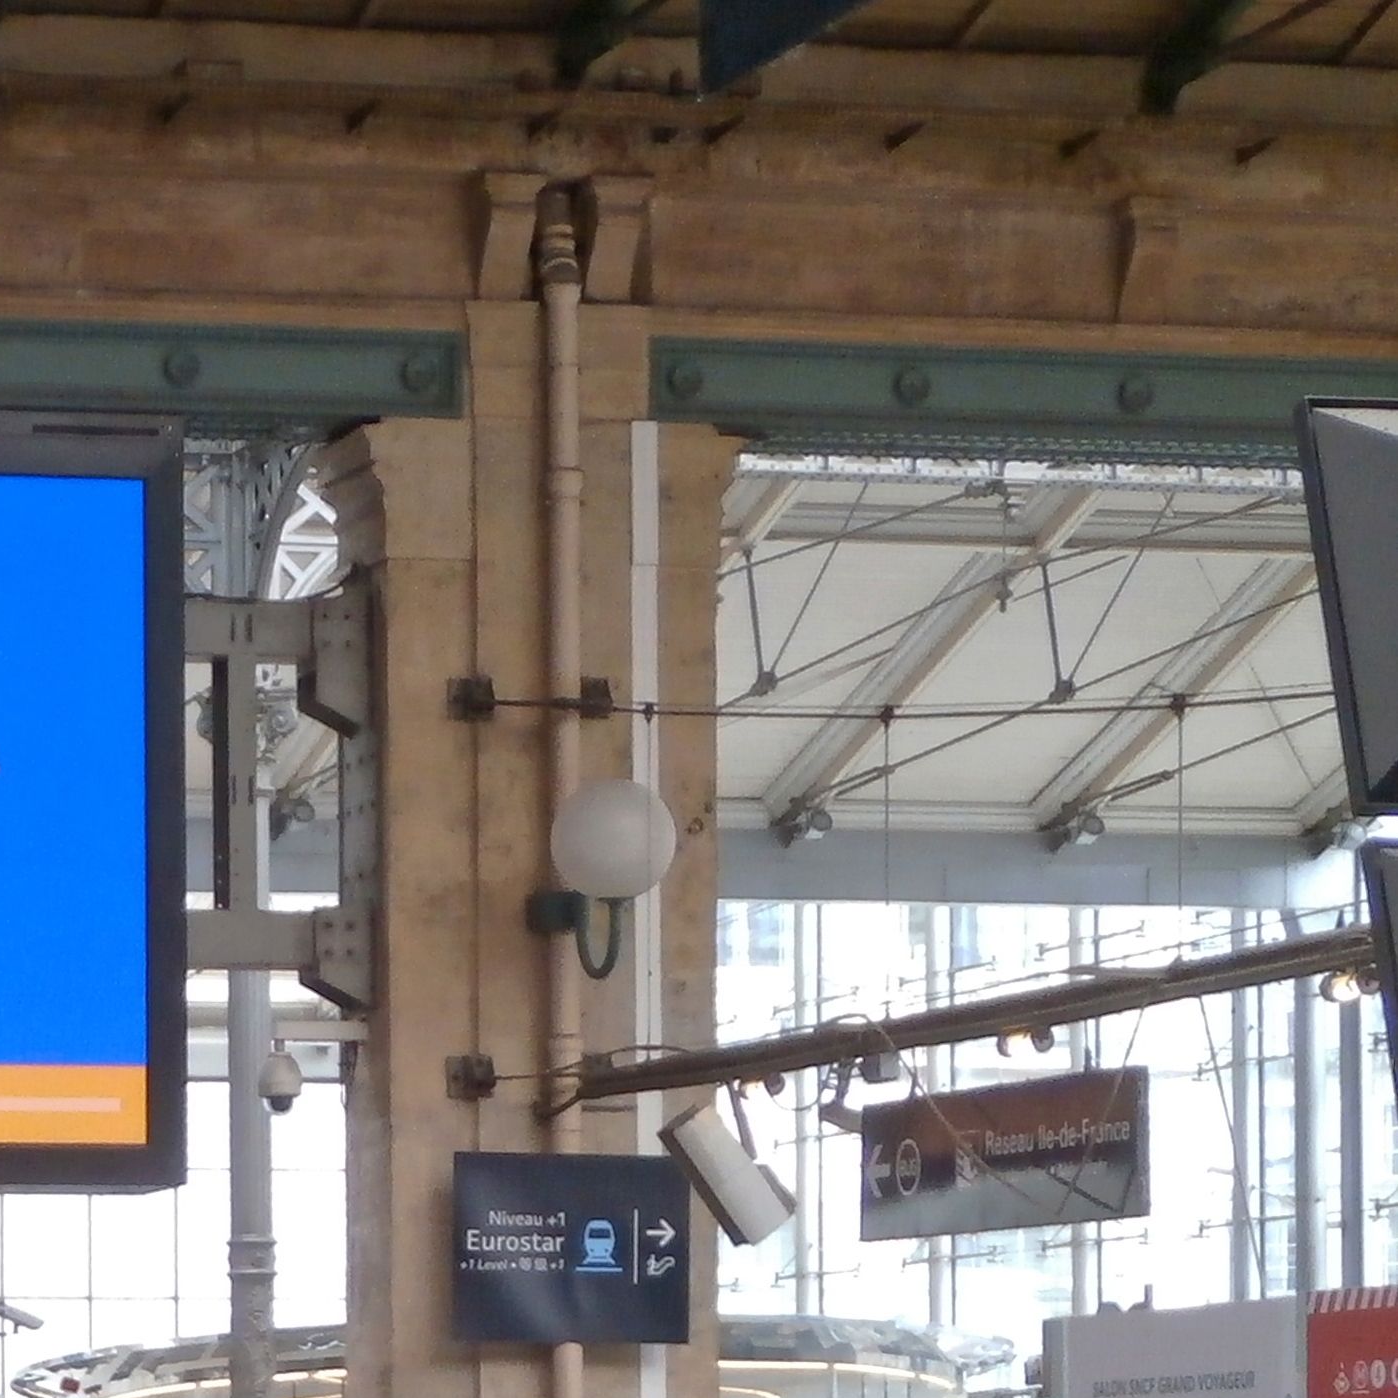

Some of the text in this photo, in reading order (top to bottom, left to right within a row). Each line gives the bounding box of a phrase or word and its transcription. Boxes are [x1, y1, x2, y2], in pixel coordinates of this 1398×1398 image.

[488, 1210, 566, 1227] Niveau +1
[466, 1229, 565, 1252] Eurostar
[1128, 1378, 1156, 1397] SNCF
[1157, 1375, 1195, 1394] GRAND
[1198, 1370, 1256, 1392] VOYAGEUR
